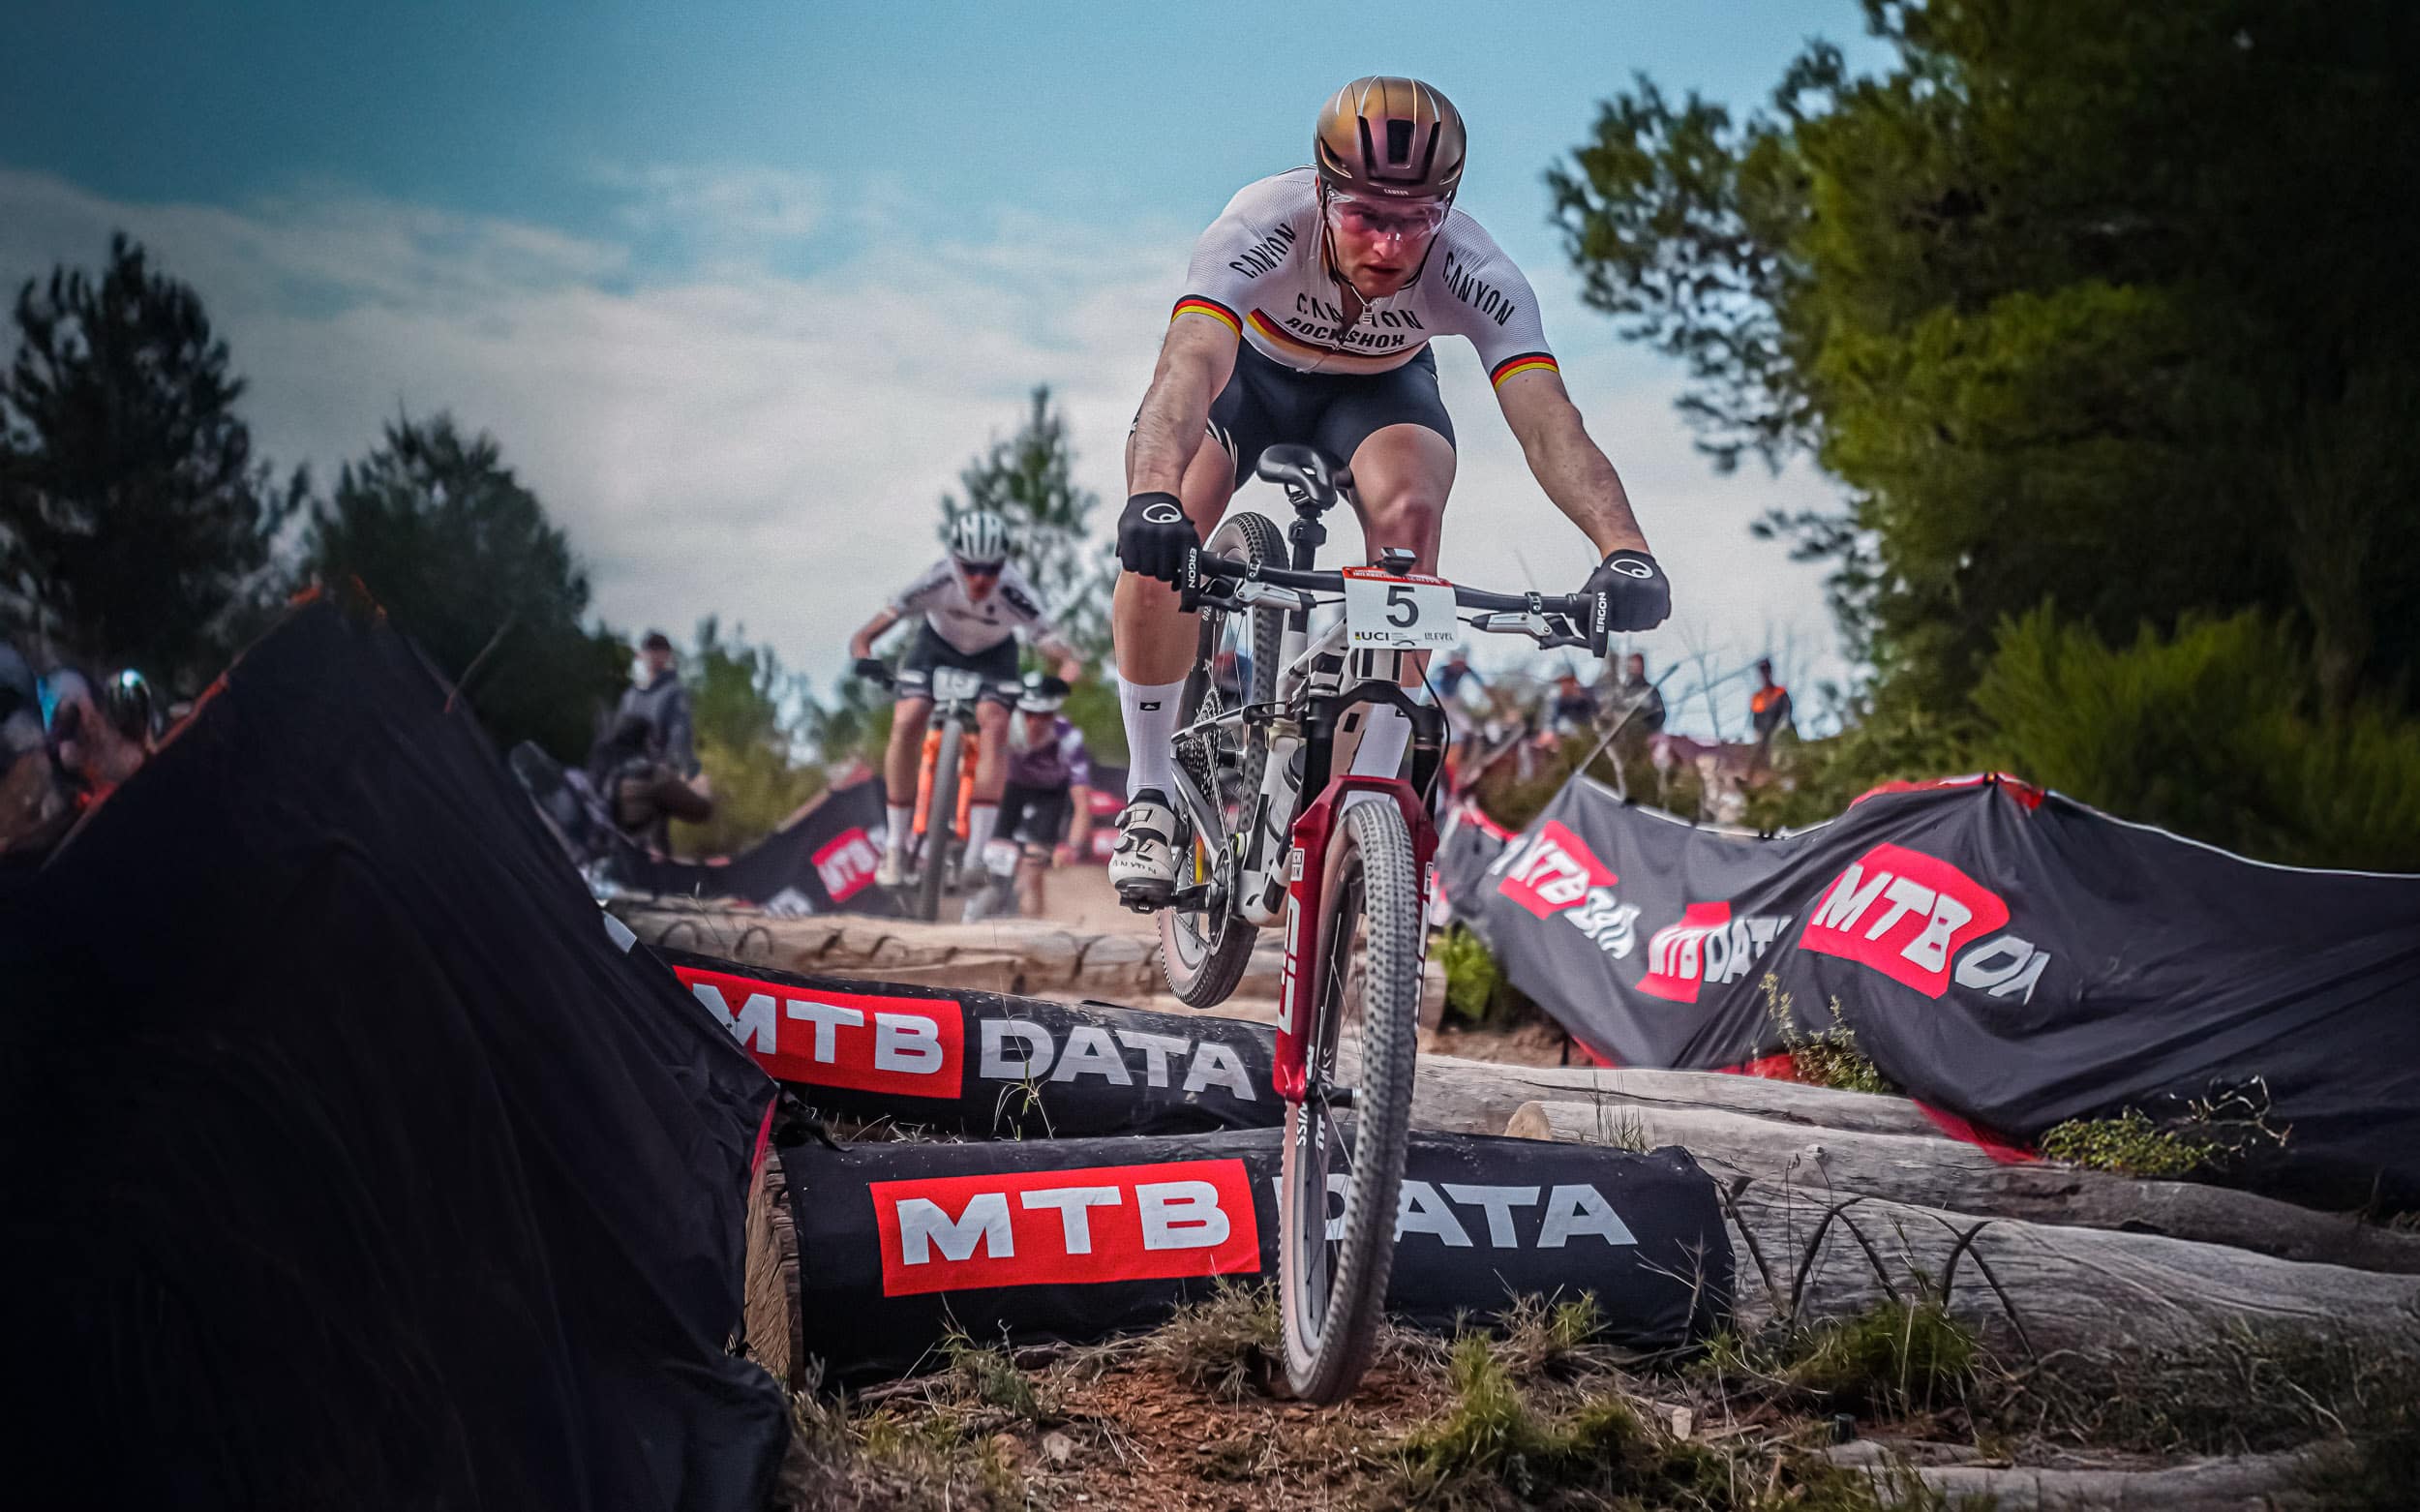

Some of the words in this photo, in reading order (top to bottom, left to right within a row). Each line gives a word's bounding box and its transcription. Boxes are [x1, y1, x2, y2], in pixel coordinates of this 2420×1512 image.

[1228, 223, 1296, 279] CANYON
[1442, 251, 1515, 326] CANYON
[1188, 547, 1197, 589] ERGON
[1386, 585, 1419, 628] 5
[1595, 591, 1608, 633] ERGON
[1361, 631, 1390, 641] UCI
[1112, 859, 1157, 875] ANYON
[1812, 862, 1973, 974] MTB
[1703, 915, 1793, 984] DAT
[693, 983, 944, 1074] MTB
[981, 1019, 1257, 1102] DATA
[896, 1180, 1231, 1265] MTB
